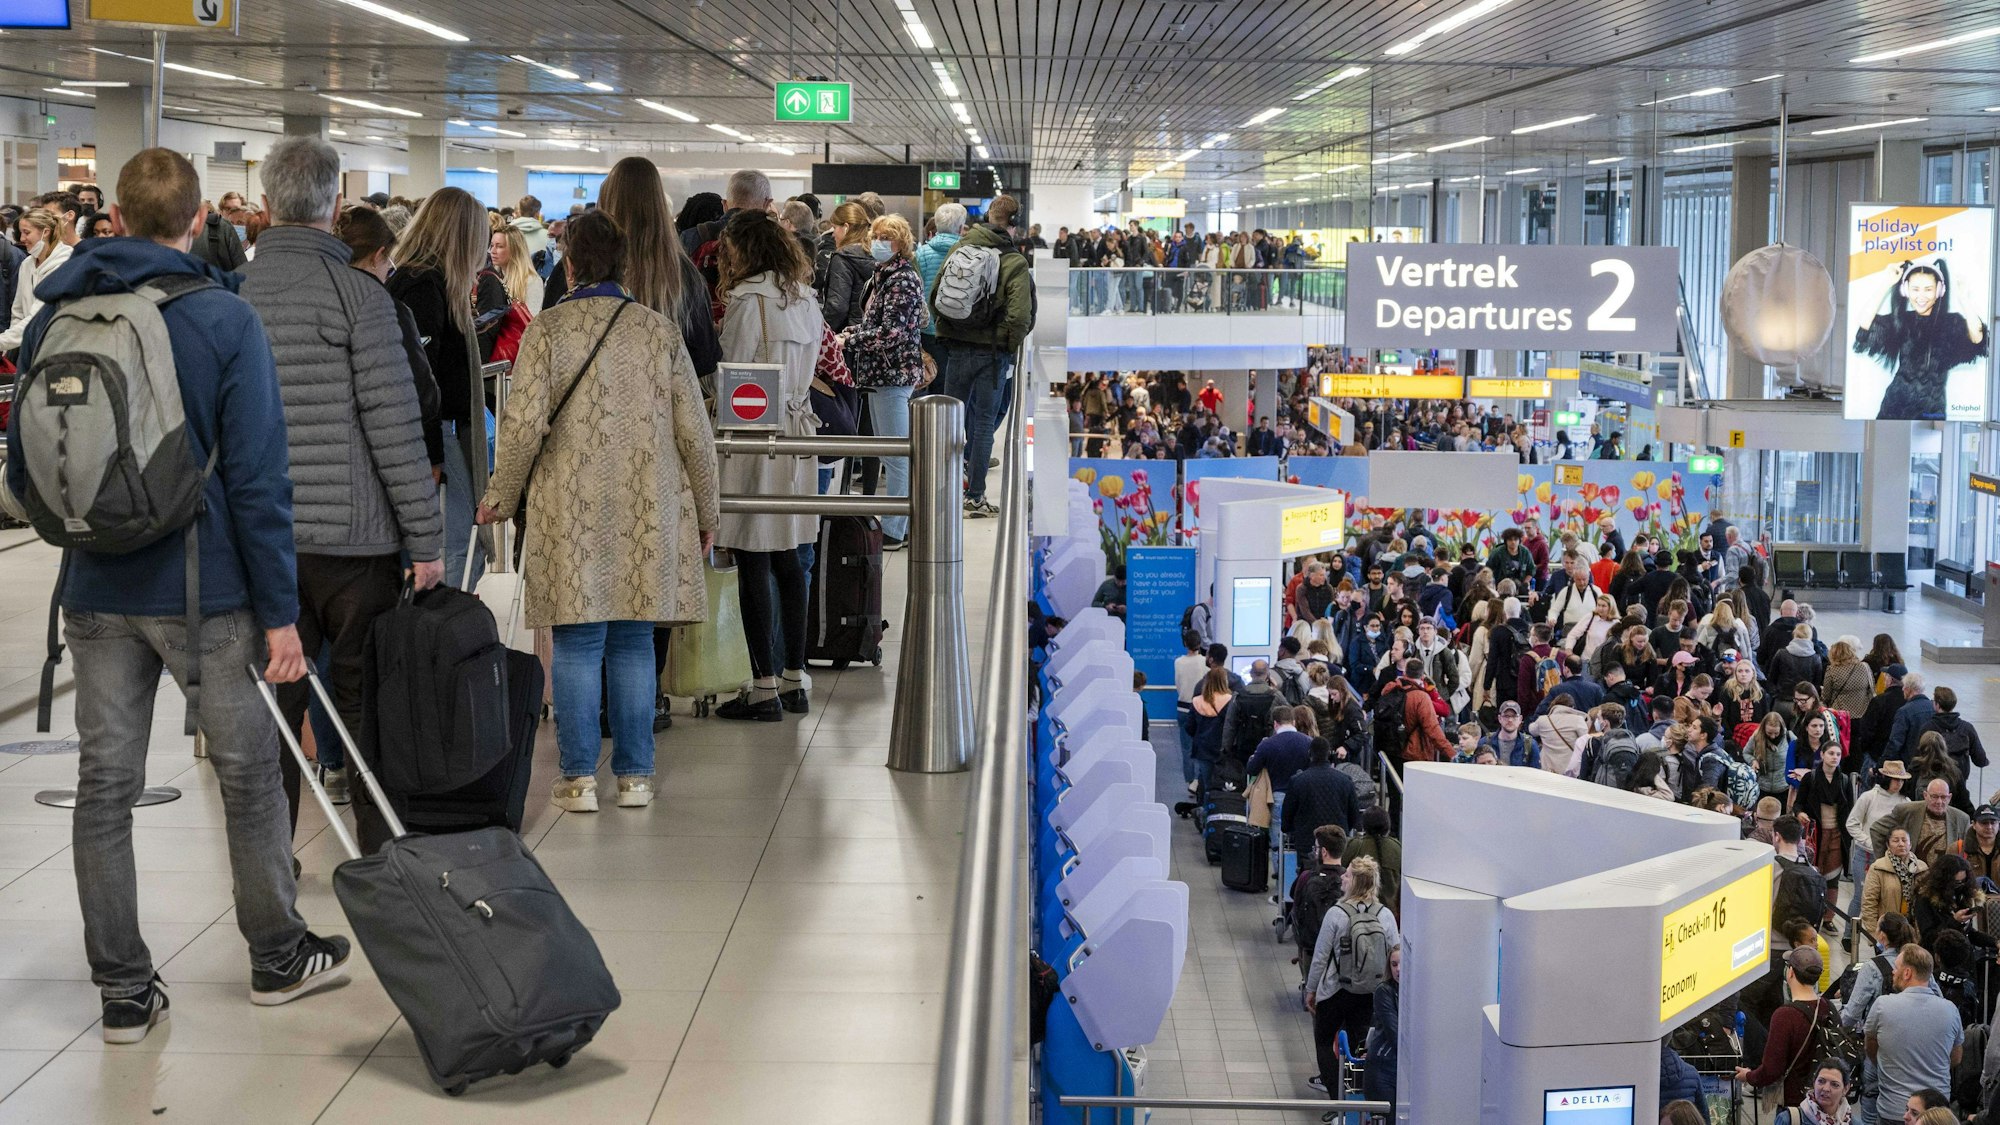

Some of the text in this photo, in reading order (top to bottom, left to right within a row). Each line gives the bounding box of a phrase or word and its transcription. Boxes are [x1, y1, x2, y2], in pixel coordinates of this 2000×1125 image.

[1857, 218, 1920, 237] Holiday
[1865, 236, 1954, 254] playlist on!
[1375, 255, 1519, 289] Vertrek
[1586, 258, 1637, 332] 2
[1375, 298, 1573, 337] Departures
[1951, 404, 1981, 412] Schiphol
[1734, 432, 1741, 446] F
[1133, 571, 1186, 580] Do you already
[1158, 580, 1190, 588] boarding
[1150, 588, 1159, 596] for
[1678, 897, 1726, 943] Check-in 16
[1662, 971, 1698, 1004] Economy
[1572, 1095, 1610, 1105] DELTA
